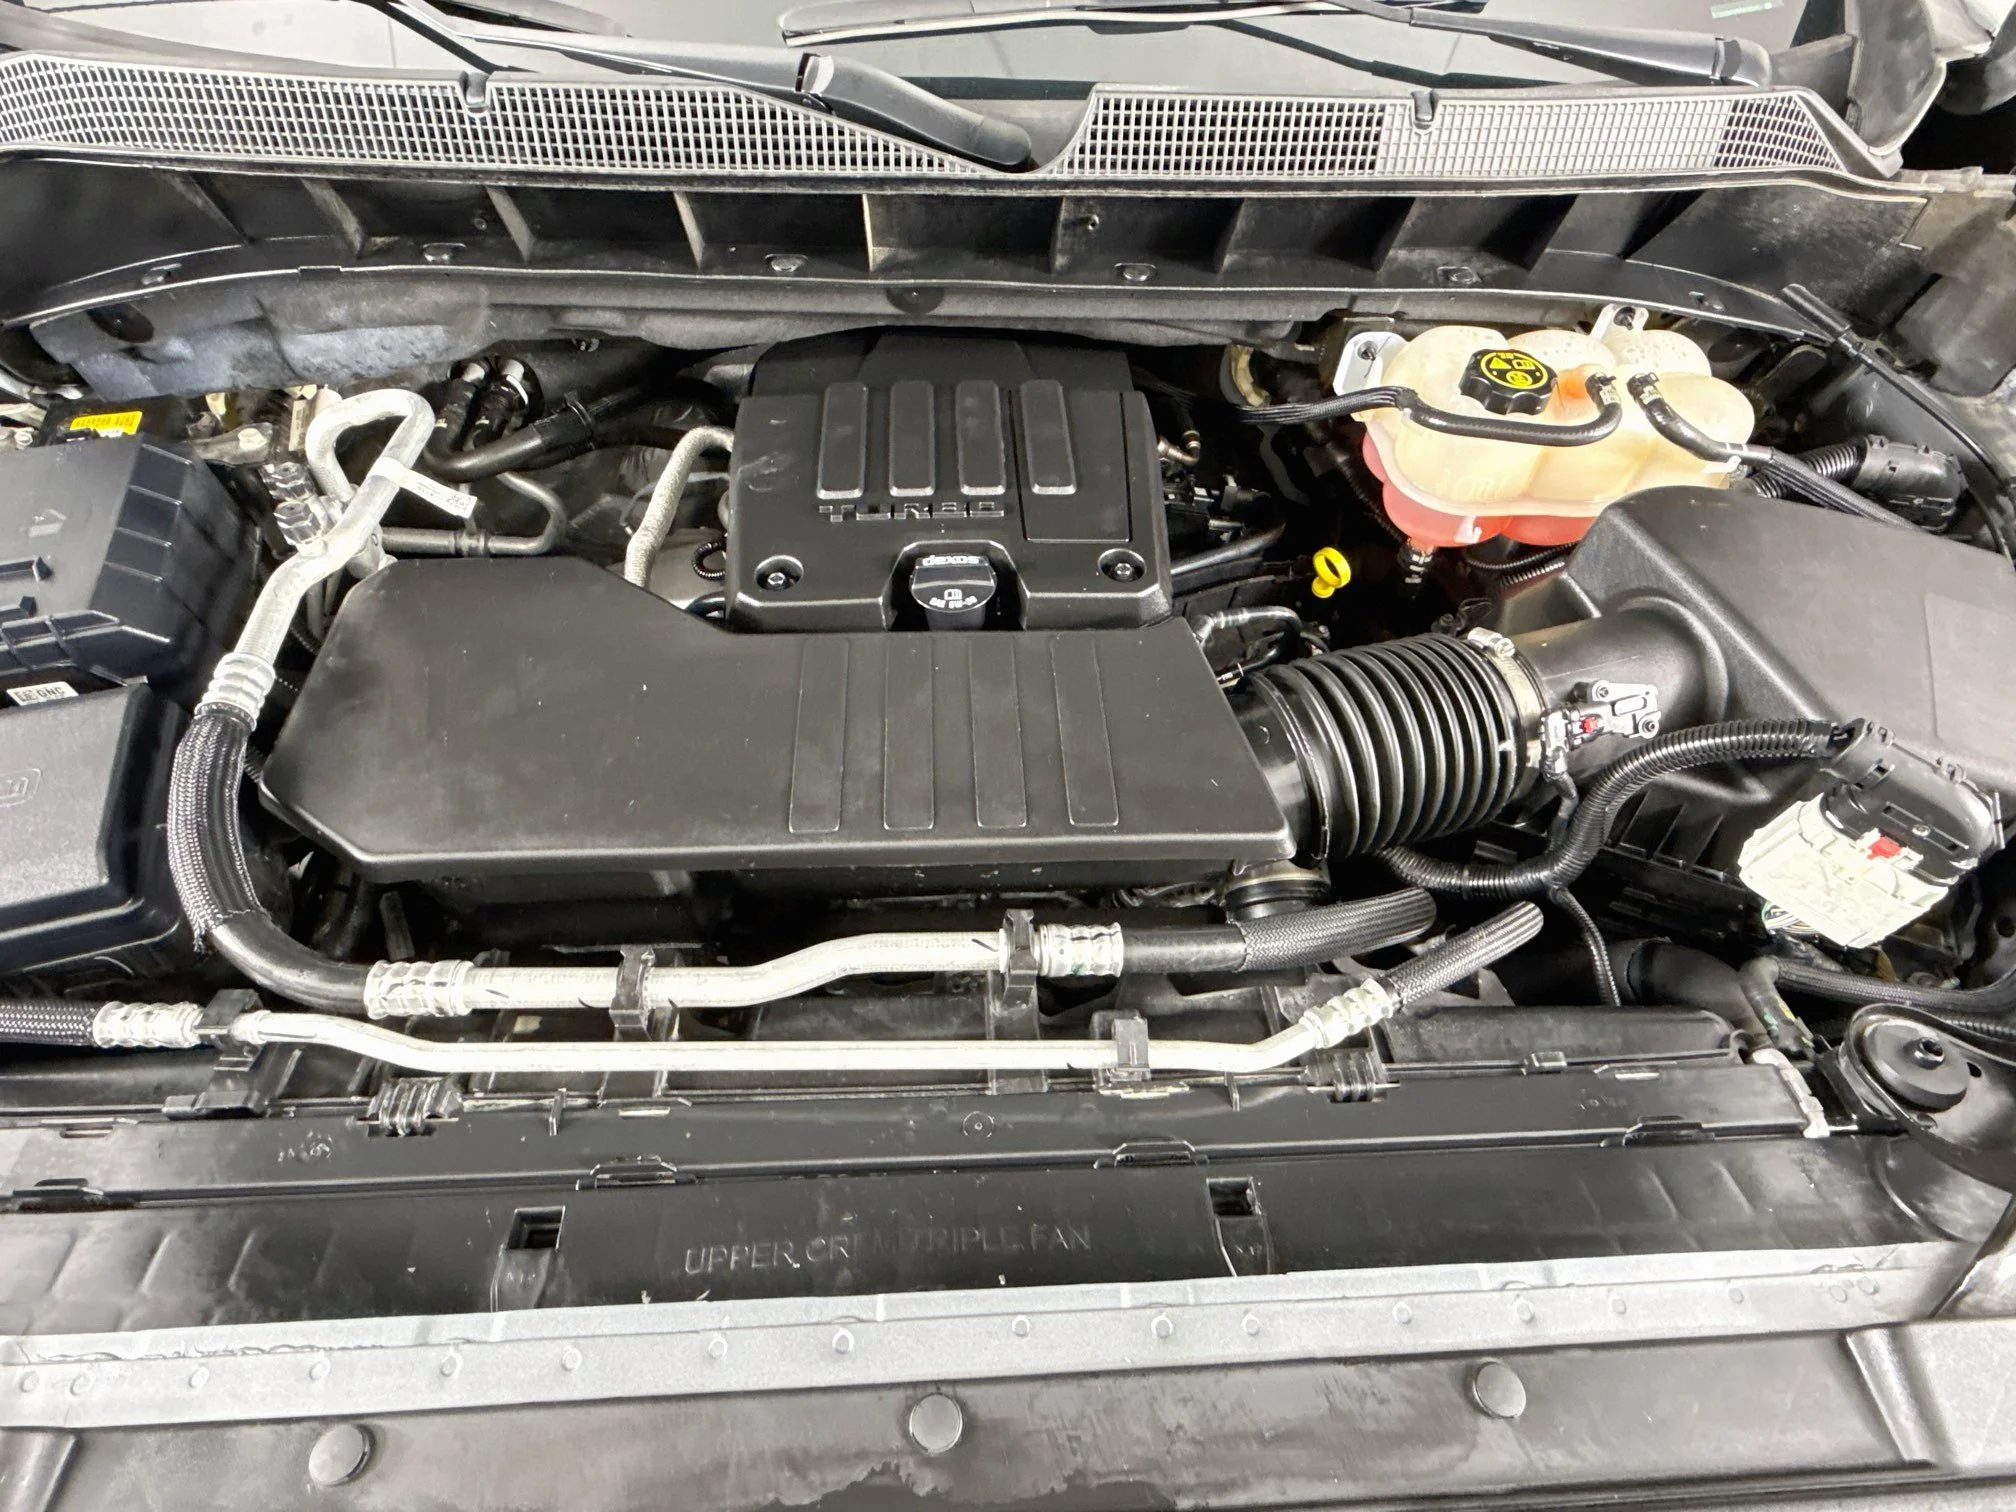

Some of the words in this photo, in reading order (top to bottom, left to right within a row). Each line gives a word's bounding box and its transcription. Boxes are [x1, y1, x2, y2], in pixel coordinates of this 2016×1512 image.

[818, 501, 1005, 522] TURBO
[922, 554, 980, 567] dexos
[684, 1237, 798, 1275] UPPER
[1029, 1221, 1092, 1251] FAN
